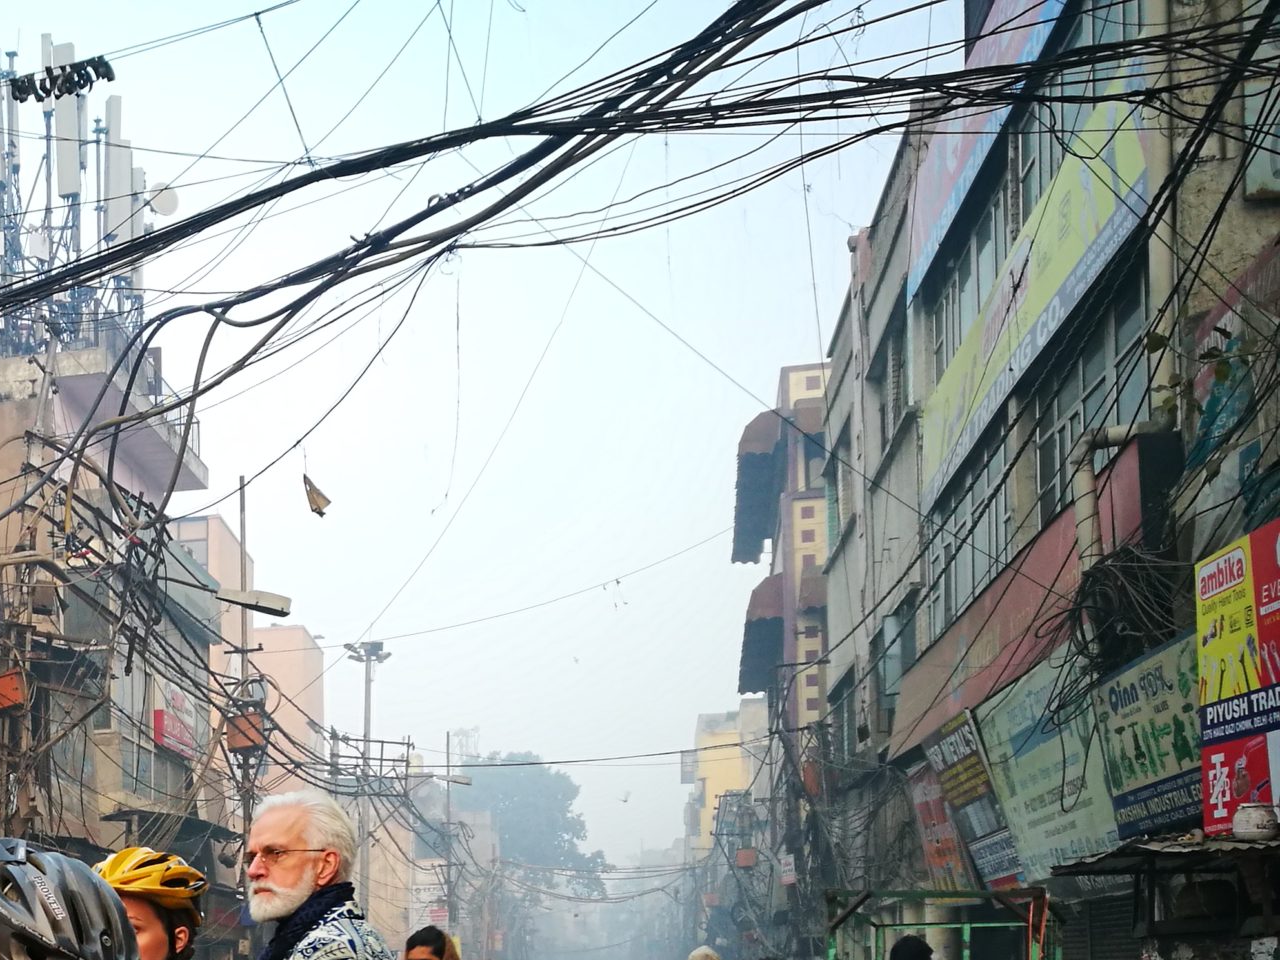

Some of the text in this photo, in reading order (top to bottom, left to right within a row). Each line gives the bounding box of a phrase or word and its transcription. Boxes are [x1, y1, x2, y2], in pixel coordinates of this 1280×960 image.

[1200, 556, 1245, 596] ambika
[1206, 696, 1249, 725] PIYUSH
[1117, 801, 1149, 825] KRISHNA
[1147, 787, 1193, 817] INDUSTRIAL
[32, 874, 67, 921] PROWELL
